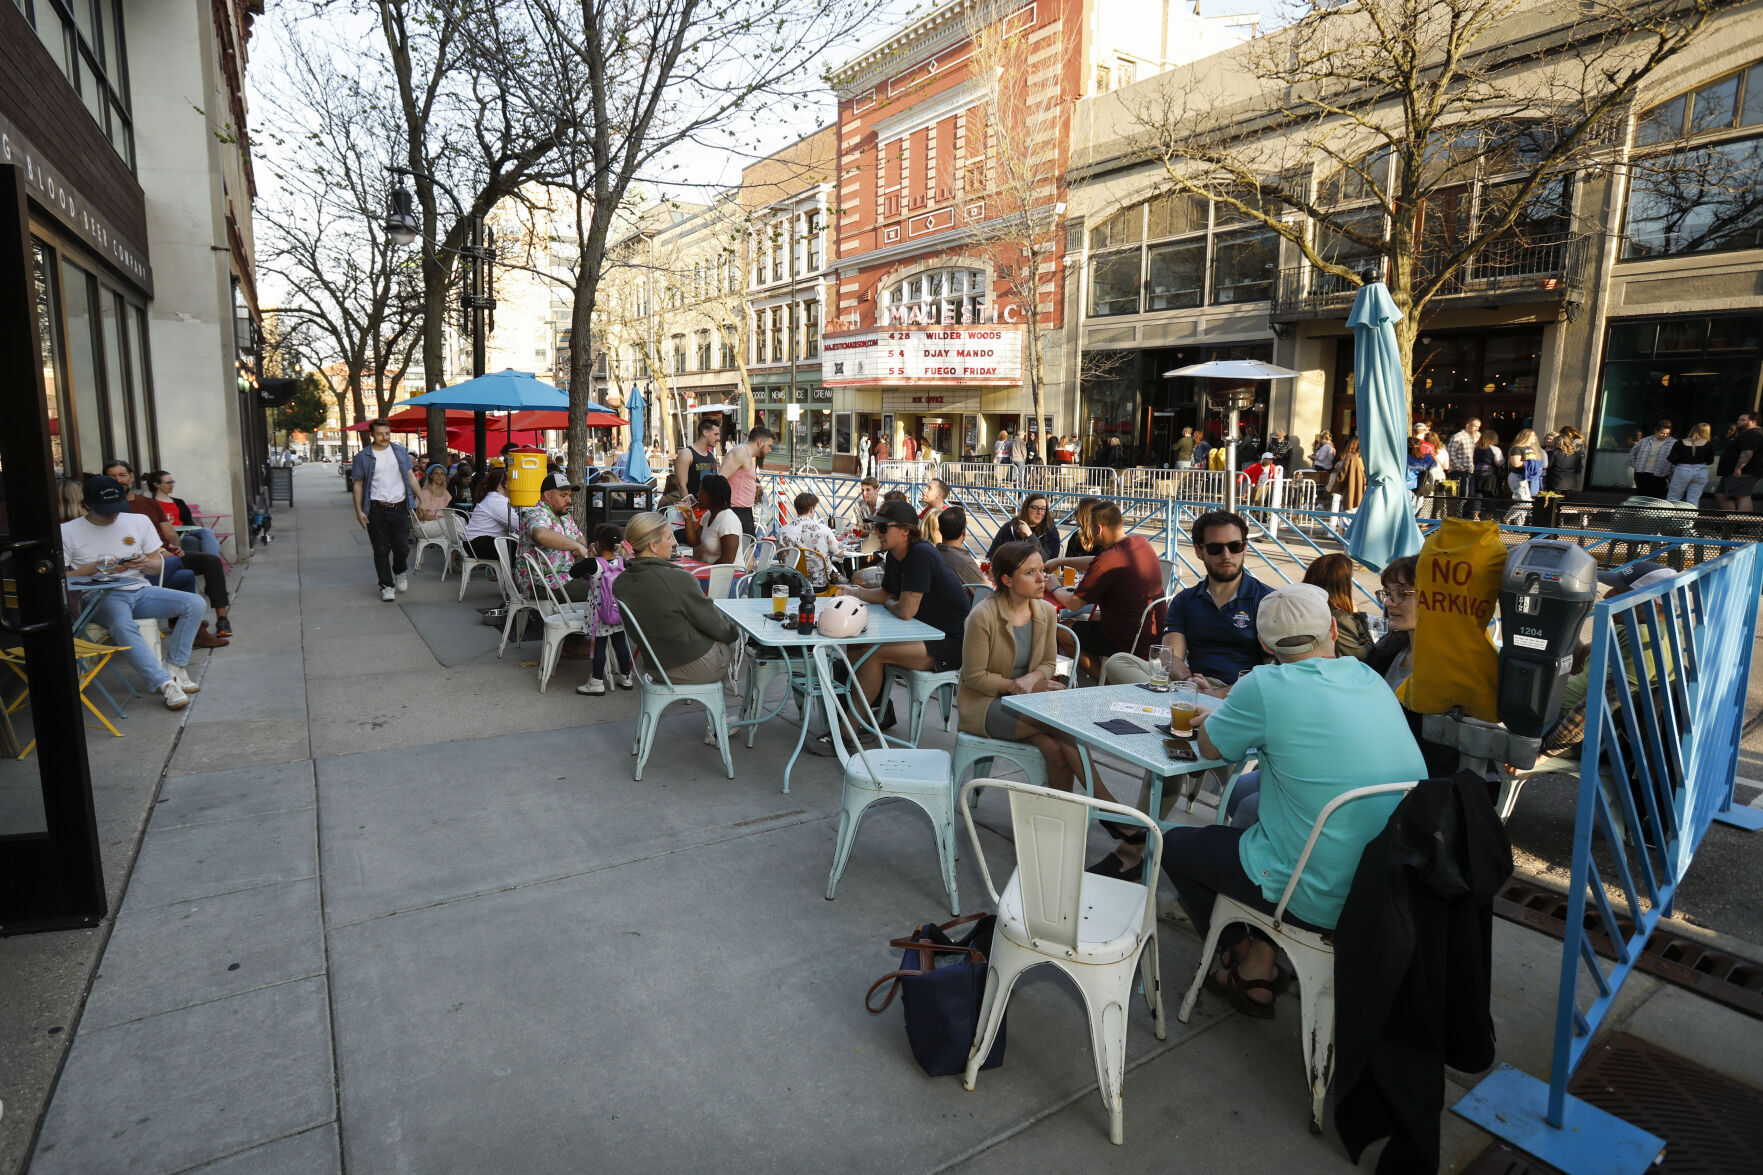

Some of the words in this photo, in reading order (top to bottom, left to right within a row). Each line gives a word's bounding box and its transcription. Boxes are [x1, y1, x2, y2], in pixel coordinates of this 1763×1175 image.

[27, 155, 75, 217] BLOOD
[84, 211, 107, 247] BEER
[114, 239, 146, 280] COMPANY
[890, 304, 1018, 324] MAJESTIC
[889, 332, 895, 340] 4
[899, 332, 910, 340] 28
[926, 332, 961, 340] WILDER
[968, 332, 1001, 340] WOODS
[771, 390, 785, 400] NEWS
[813, 389, 833, 399] CREAM
[1432, 558, 1473, 586] NO
[1417, 590, 1490, 619] ARKIG
[1520, 626, 1543, 636] 1204
